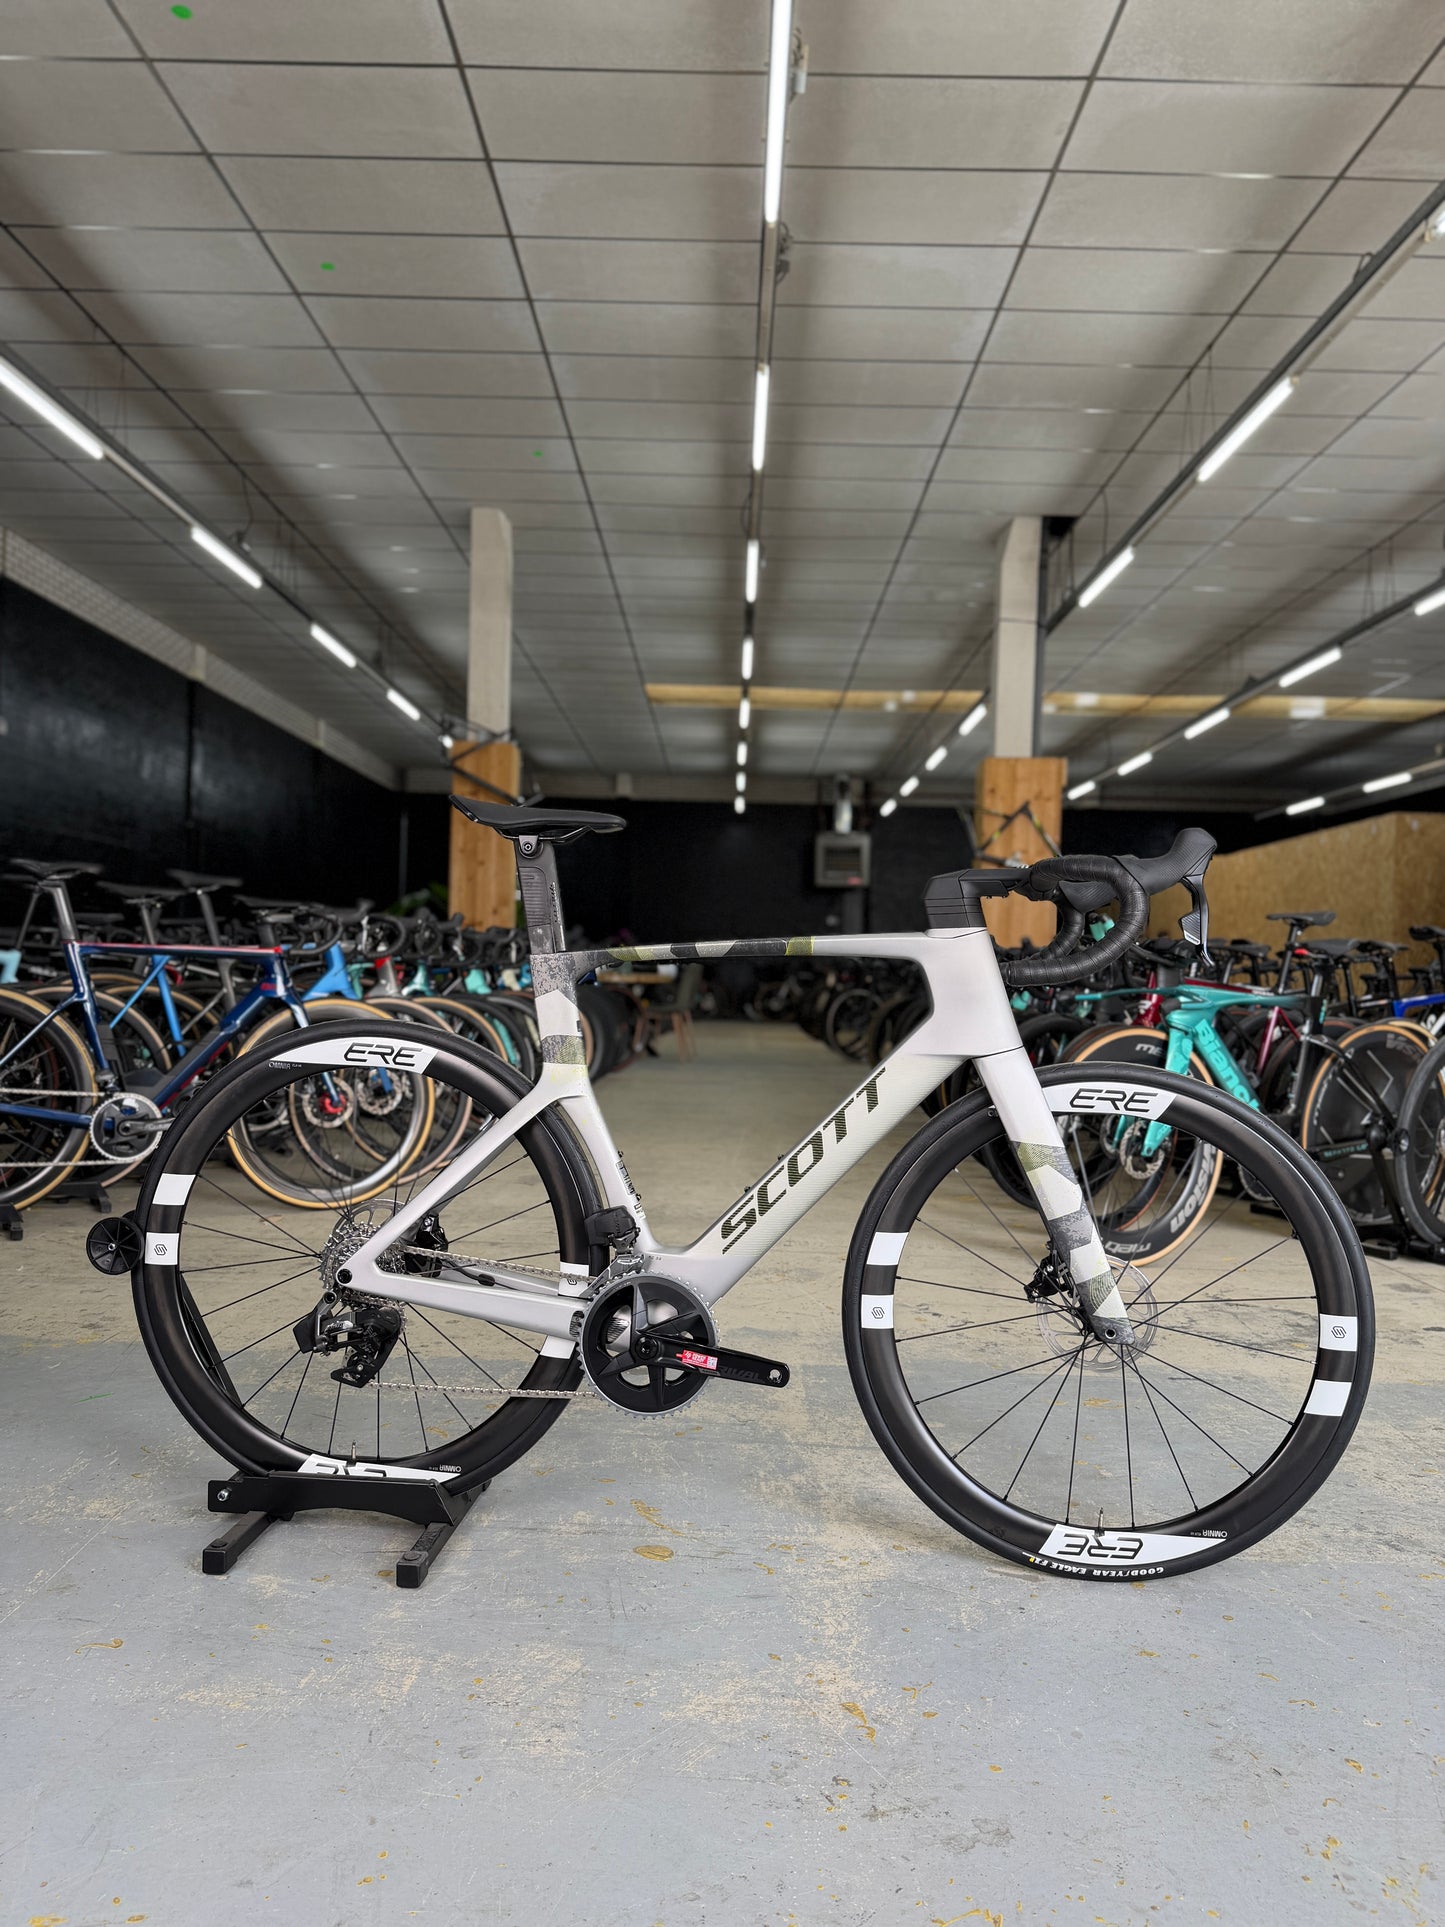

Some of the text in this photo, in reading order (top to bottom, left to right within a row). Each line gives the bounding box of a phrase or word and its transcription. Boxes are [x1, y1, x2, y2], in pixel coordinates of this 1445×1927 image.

[344, 1042, 423, 1067] ERE
[1195, 1019, 1260, 1112] Bianc
[1069, 1088, 1159, 1112] ERE
[721, 1066, 886, 1255] SCOTT
[1056, 1533, 1144, 1559] ERE
[1051, 1563, 1088, 1575] EAGLE
